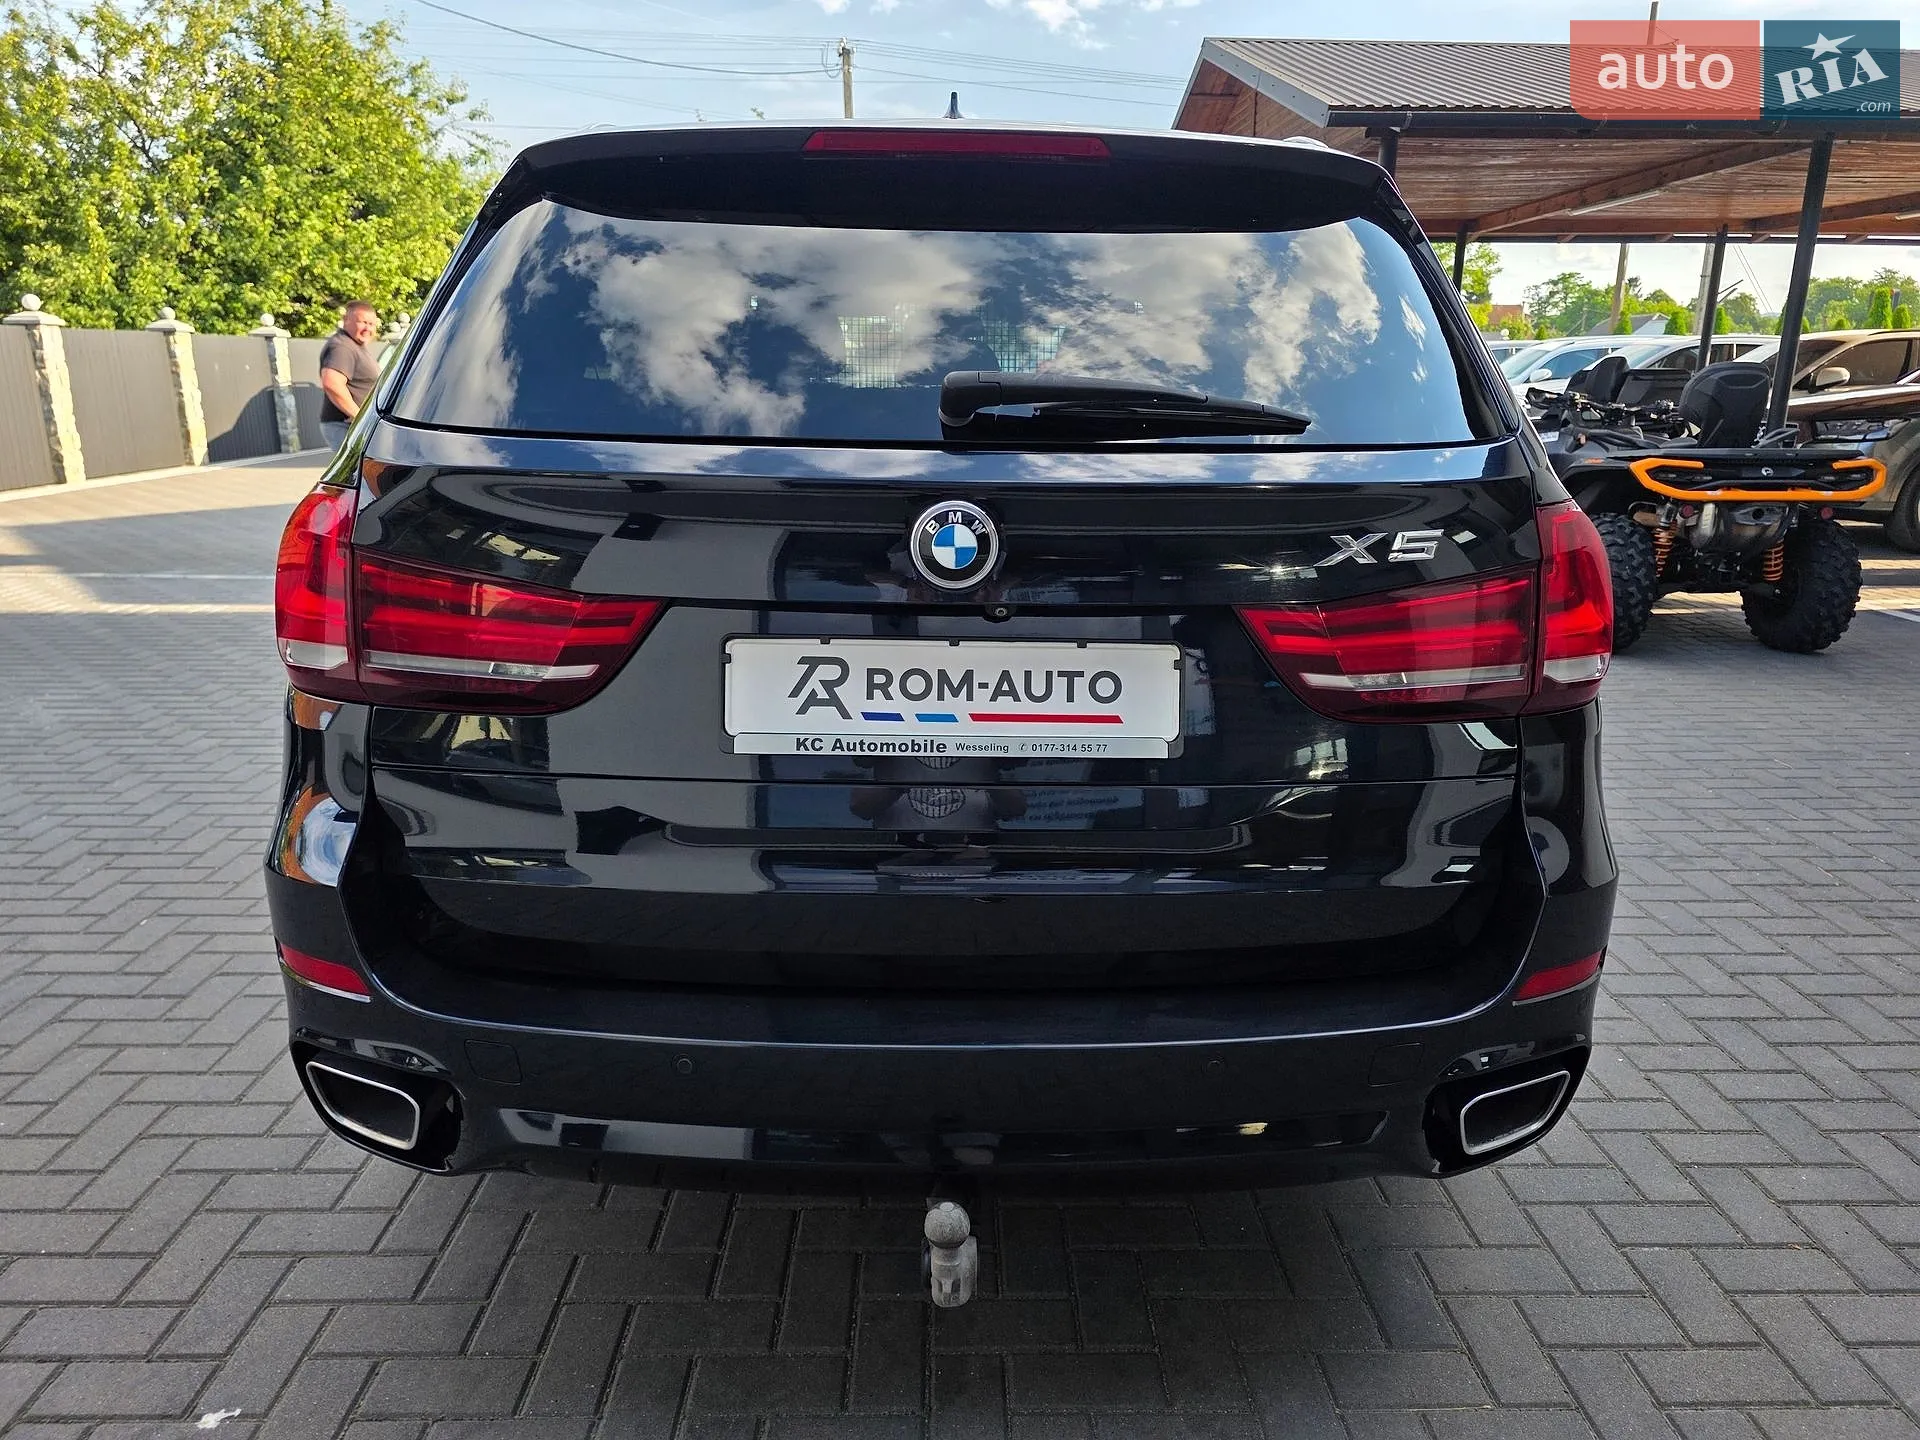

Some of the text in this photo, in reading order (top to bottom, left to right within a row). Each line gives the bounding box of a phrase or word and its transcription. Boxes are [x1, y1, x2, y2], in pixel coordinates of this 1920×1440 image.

[924, 511, 987, 536] BMW
[1313, 529, 1444, 567] X5
[865, 668, 1123, 704] ROM-AUTO
[795, 737, 1108, 754] KC Automobile Wesseling 0177-314 55 77
